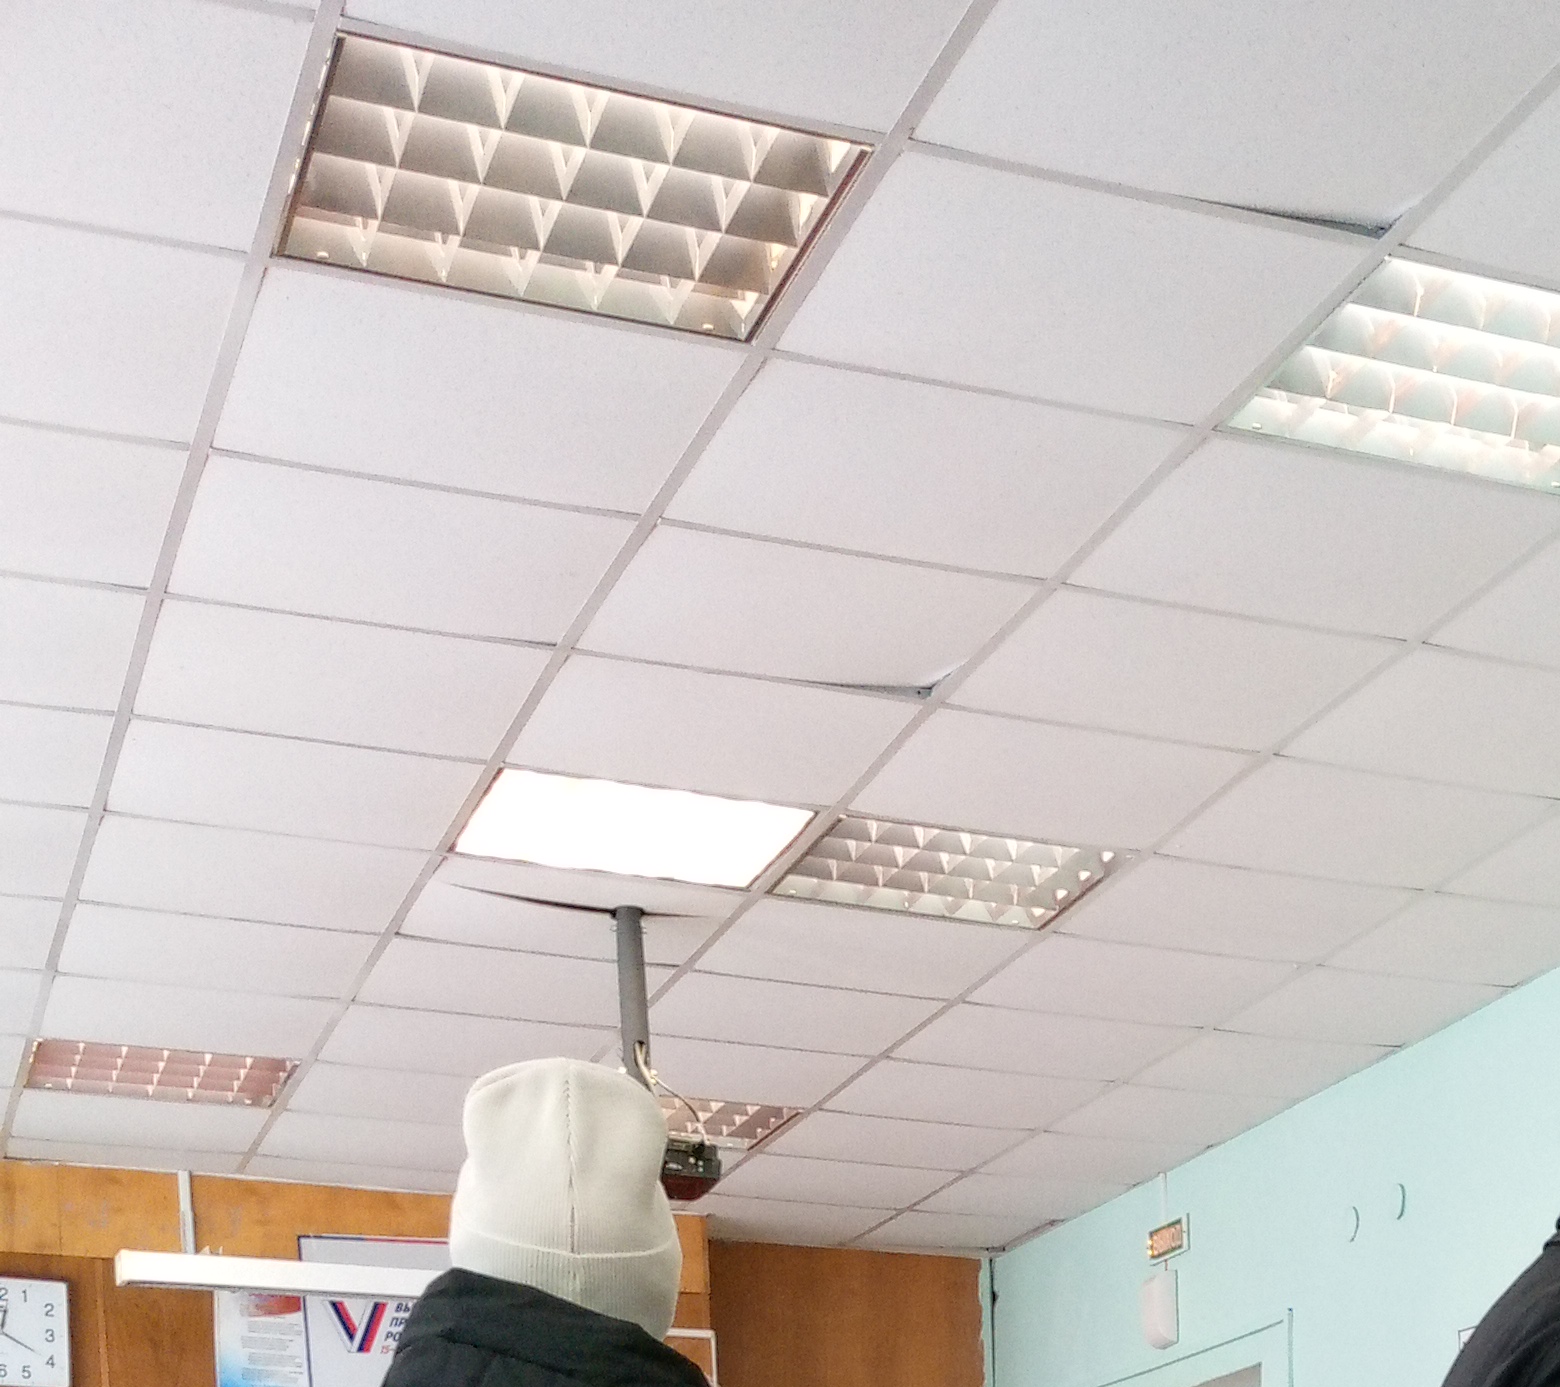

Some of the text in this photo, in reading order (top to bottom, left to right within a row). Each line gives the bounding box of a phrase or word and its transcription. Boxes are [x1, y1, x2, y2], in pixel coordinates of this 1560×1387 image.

[21, 1288, 28, 1303] 1
[44, 1302, 55, 1318] 2
[44, 1328, 55, 1343] 3
[45, 1354, 56, 1369] 4
[21, 1364, 32, 1380] 5
